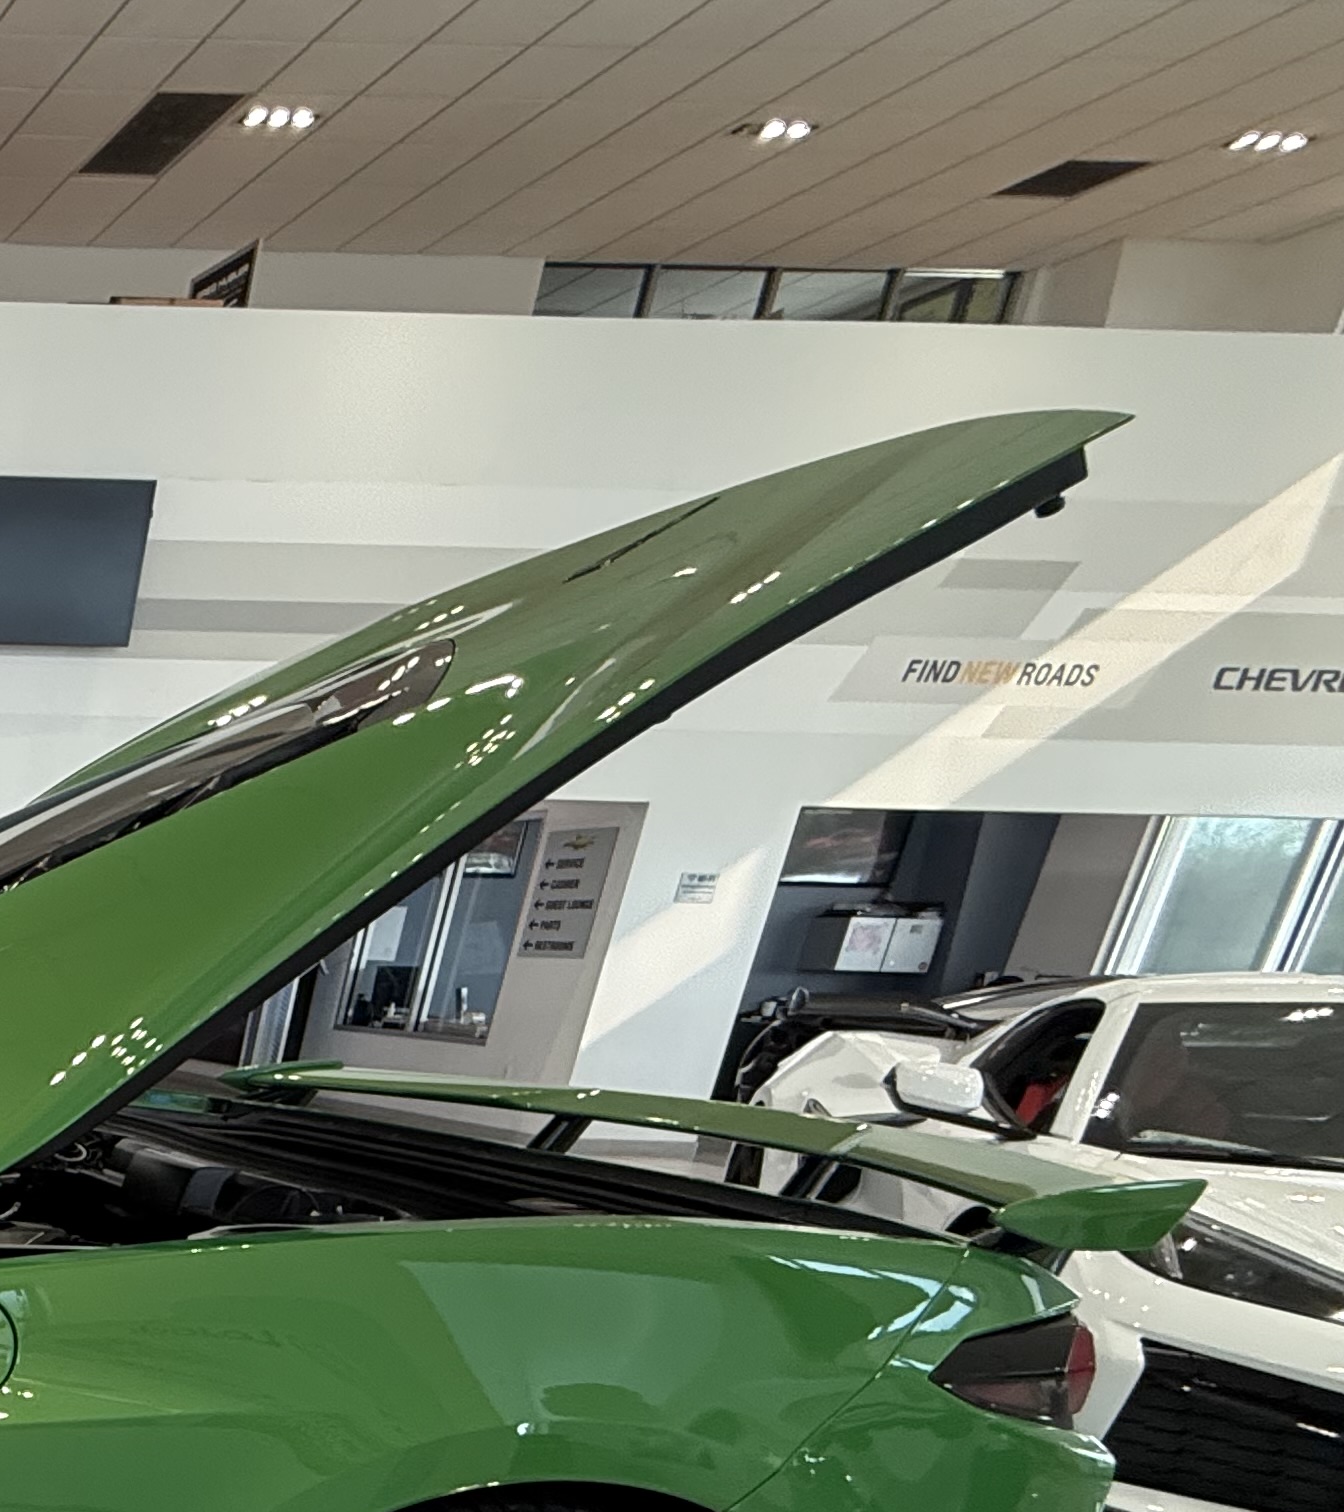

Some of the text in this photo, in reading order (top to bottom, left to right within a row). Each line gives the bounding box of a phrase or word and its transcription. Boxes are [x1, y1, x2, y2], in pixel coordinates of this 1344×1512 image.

[900, 659, 1100, 687] FIND NEW ROADS
[1213, 666, 1344, 693] CHEVR
